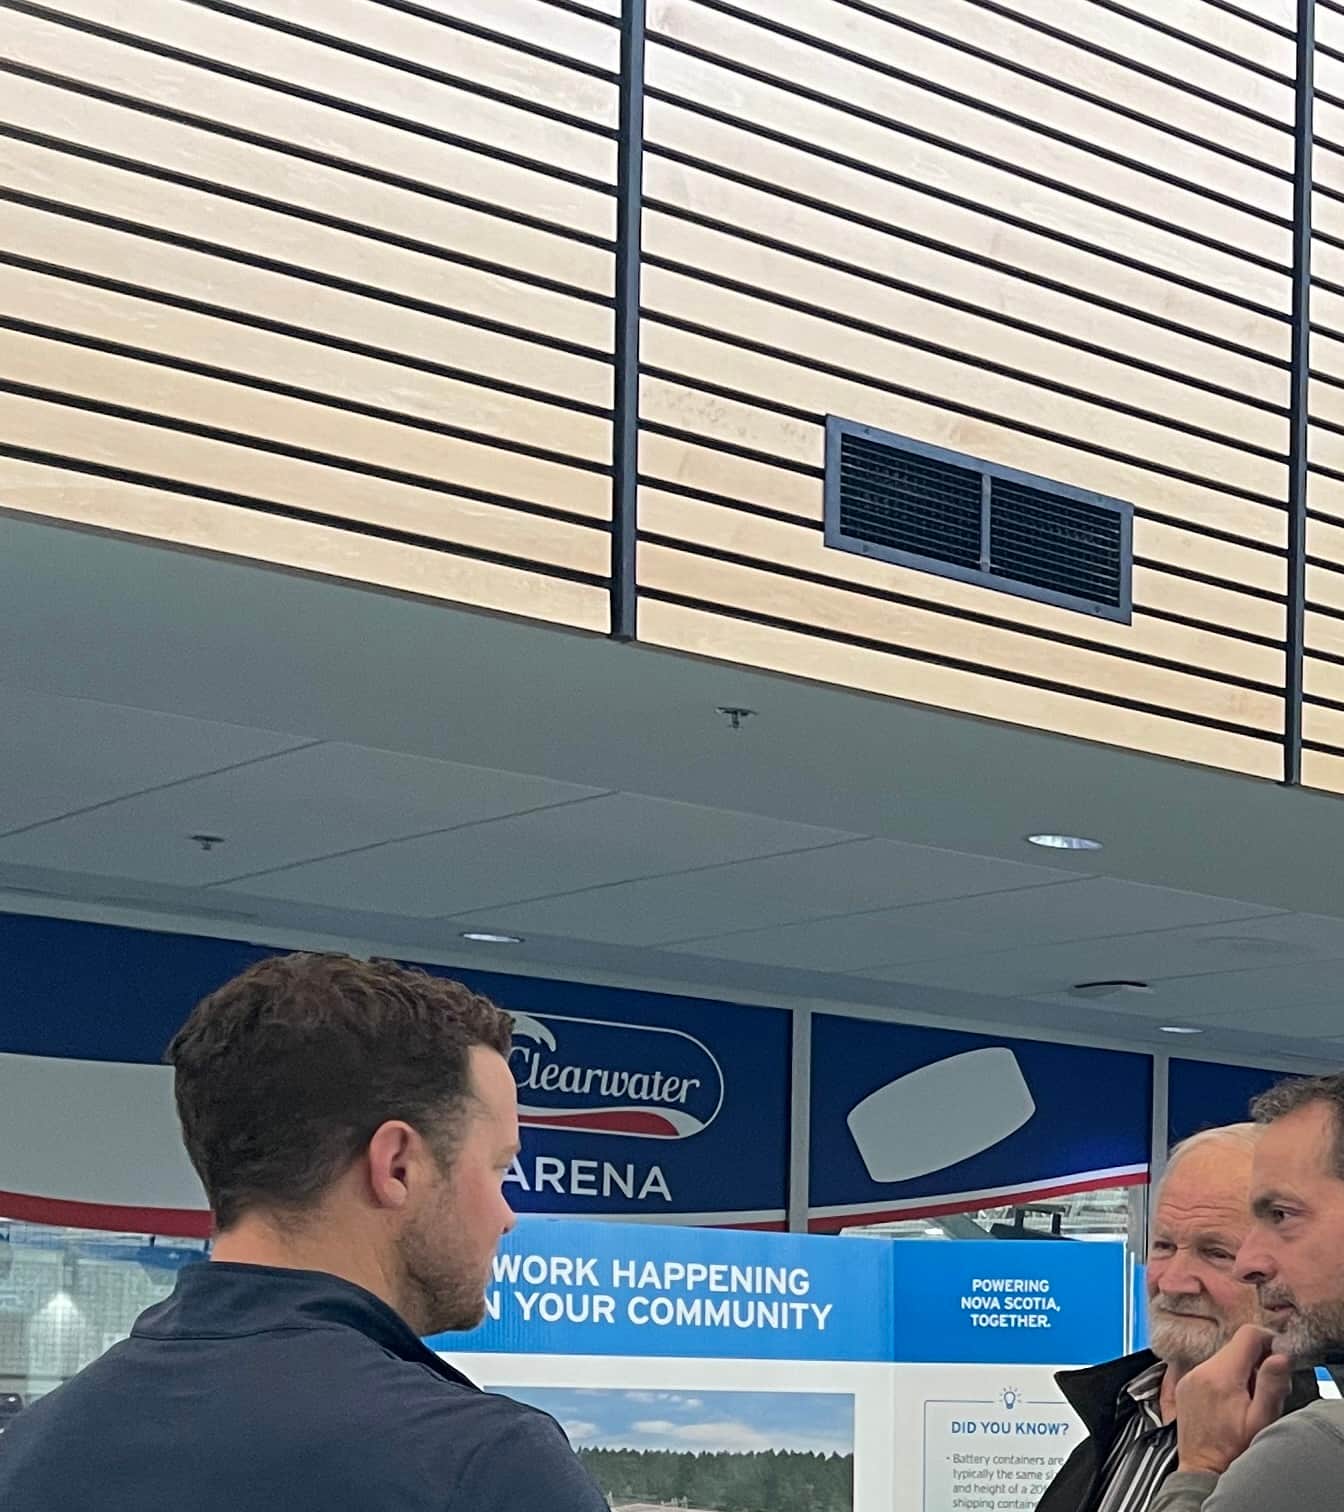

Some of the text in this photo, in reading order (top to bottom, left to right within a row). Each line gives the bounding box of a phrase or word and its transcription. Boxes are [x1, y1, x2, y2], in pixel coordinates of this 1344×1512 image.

[508, 1046, 700, 1104] Clearwater
[501, 1153, 673, 1202] ARENA
[491, 1254, 811, 1296] WORK HAPPENING
[972, 1279, 1050, 1293] POWERING
[484, 1290, 833, 1331] N YOUR COMMUNITY
[961, 1296, 1061, 1312] NOVA SCOTIA,
[970, 1314, 1052, 1328] TOGETHER.
[951, 1421, 1070, 1436] DID YOU KNOW?
[952, 1453, 992, 1467] Battery
[993, 1454, 1045, 1466] containers
[952, 1467, 994, 1481] typically
[996, 1468, 1014, 1480] the
[1015, 1470, 1044, 1480] same
[952, 1483, 972, 1494] and
[973, 1482, 1006, 1496] height
[1007, 1483, 1019, 1494] of
[952, 1497, 995, 1510] shipping
